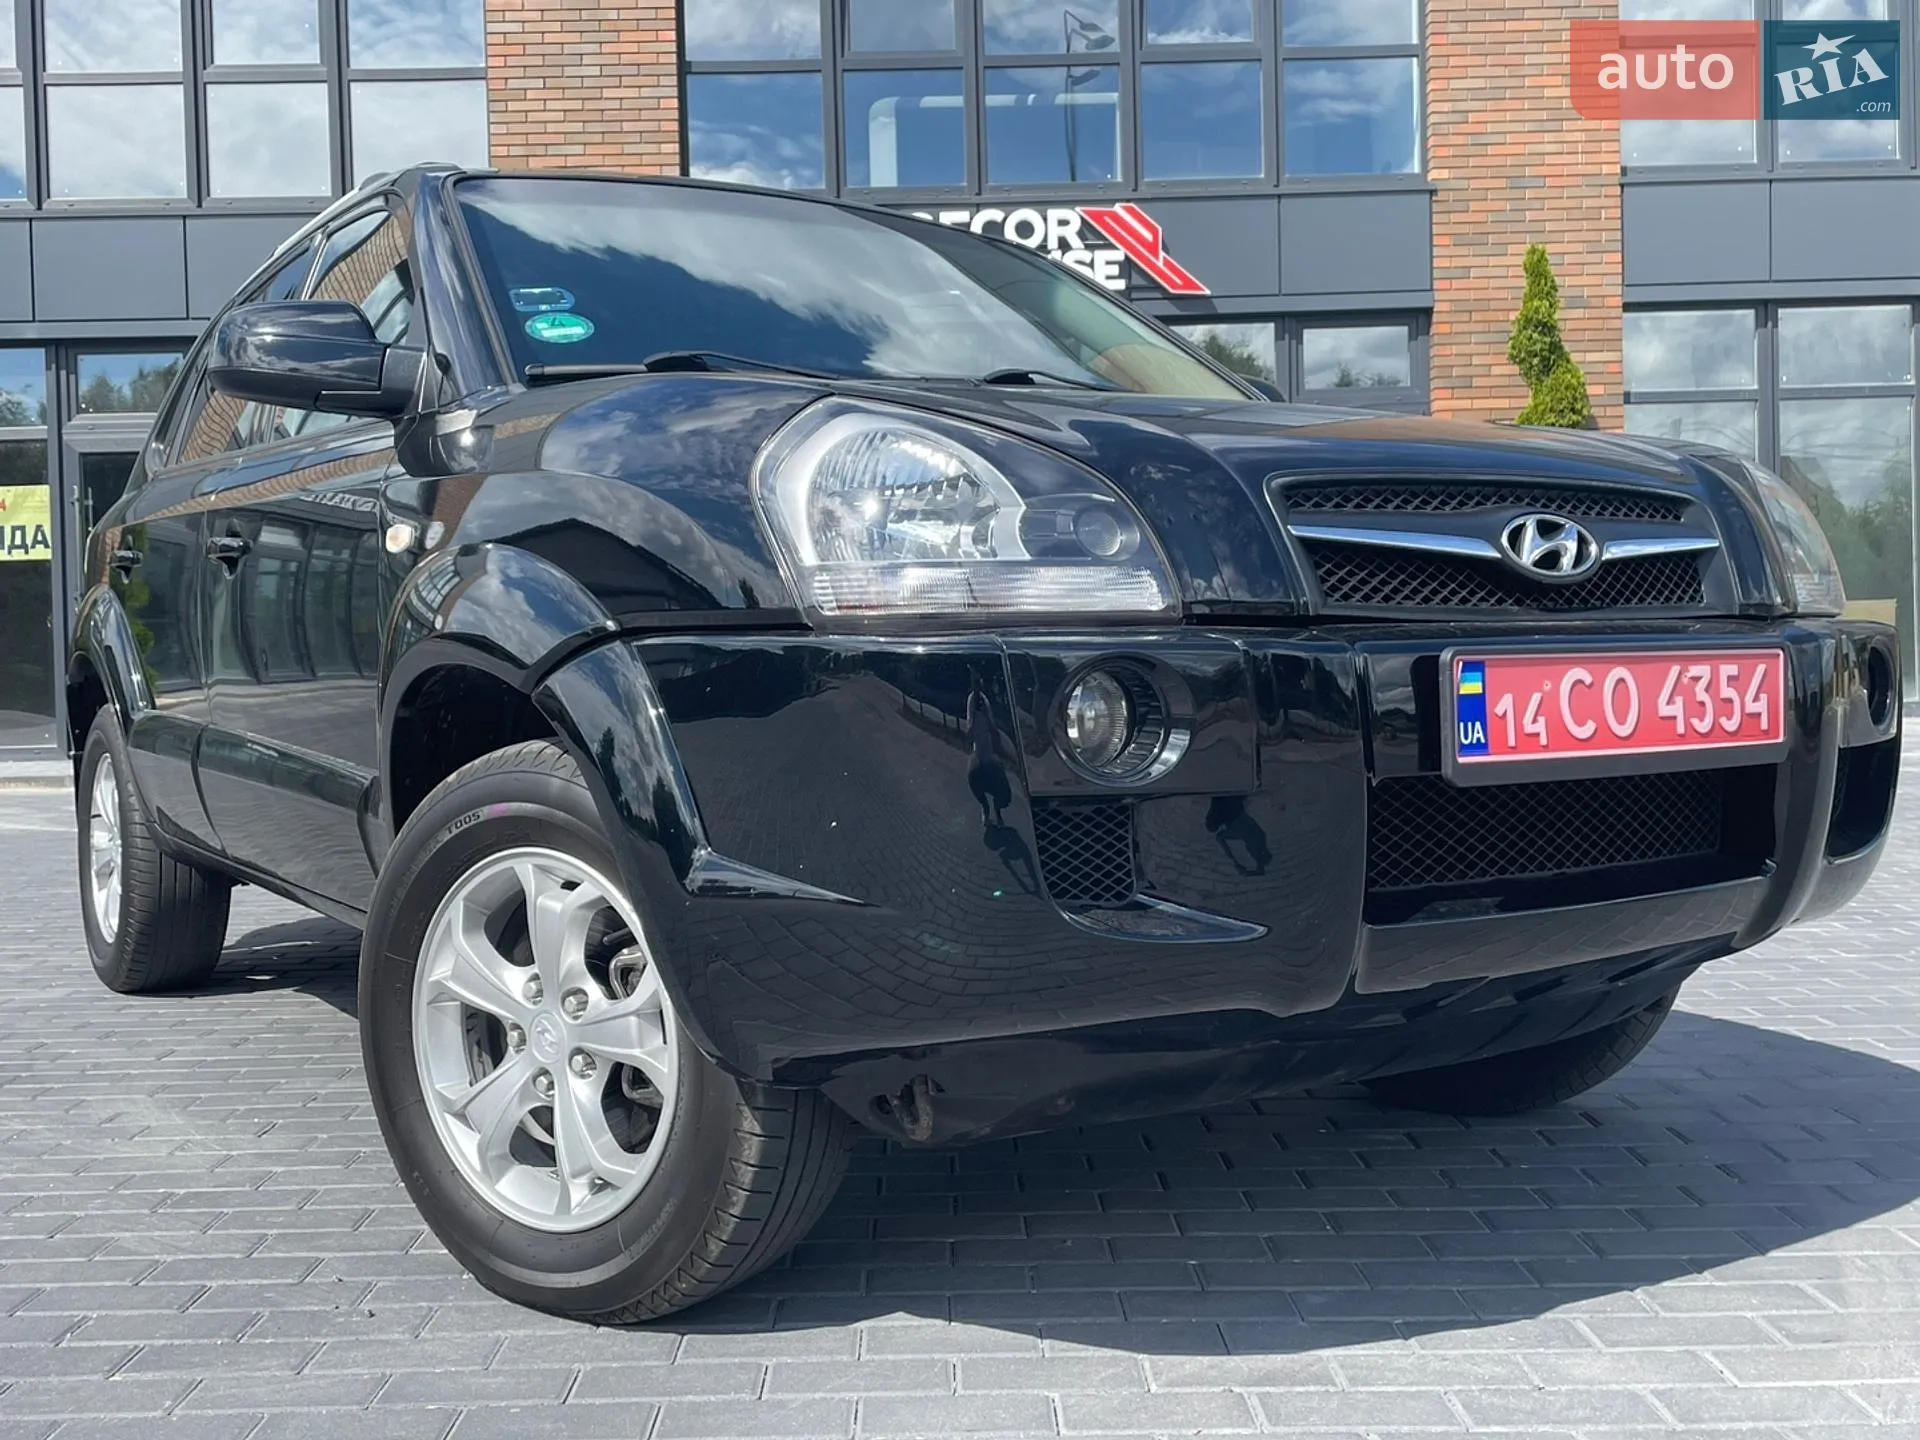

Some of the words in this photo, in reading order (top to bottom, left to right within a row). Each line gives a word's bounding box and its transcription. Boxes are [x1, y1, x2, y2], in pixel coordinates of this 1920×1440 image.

[911, 208, 1082, 249] COR
[1460, 720, 1485, 745] UA
[1494, 692, 1548, 748] 14
[1657, 664, 1768, 735] 4354
